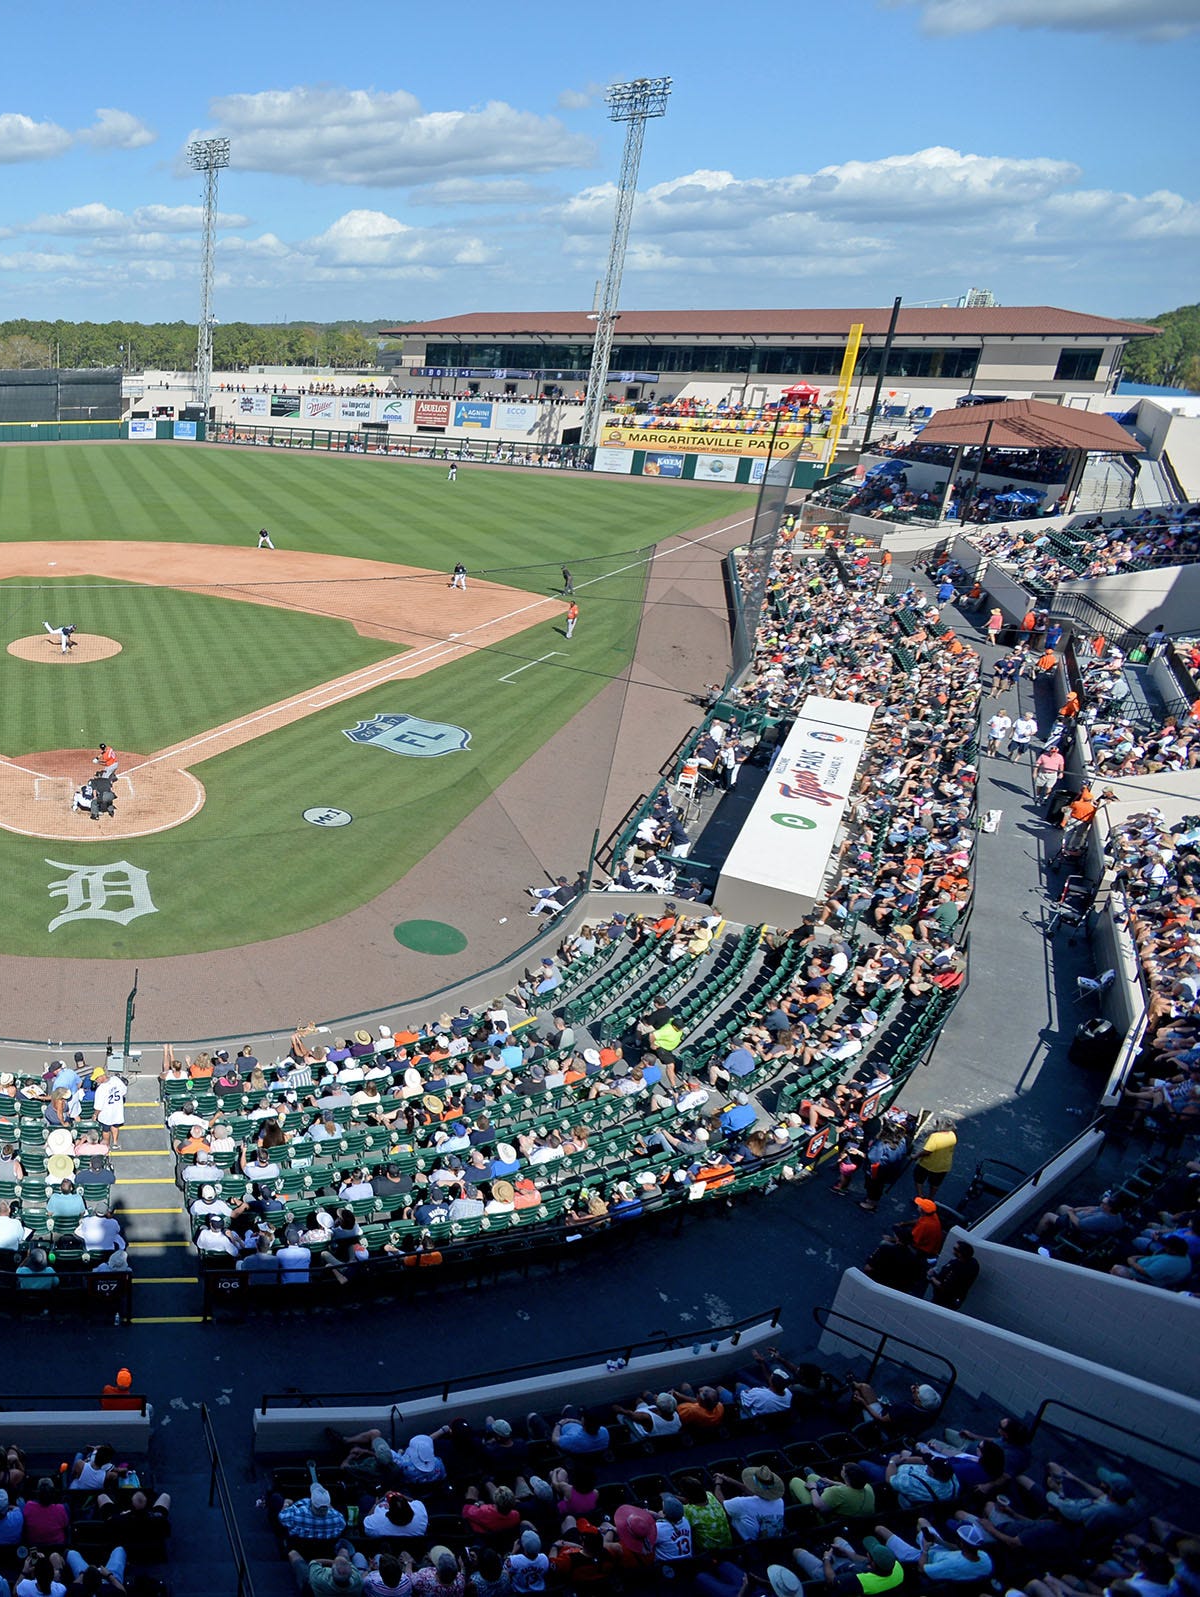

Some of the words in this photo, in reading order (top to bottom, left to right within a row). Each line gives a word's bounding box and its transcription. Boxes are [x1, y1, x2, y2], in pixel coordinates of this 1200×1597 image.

[349, 401, 370, 409] Imperial
[506, 408, 526, 416] ECCO
[356, 410, 370, 418] Hotel
[628, 434, 743, 448] MARGARITAVILLE
[748, 440, 790, 450] PATIO
[656, 457, 682, 468] KAYEM
[393, 730, 447, 748] FL
[795, 749, 826, 771] FANS
[777, 769, 845, 807] Tigers
[108, 1090, 120, 1104] 25
[677, 1538, 690, 1555] 13
